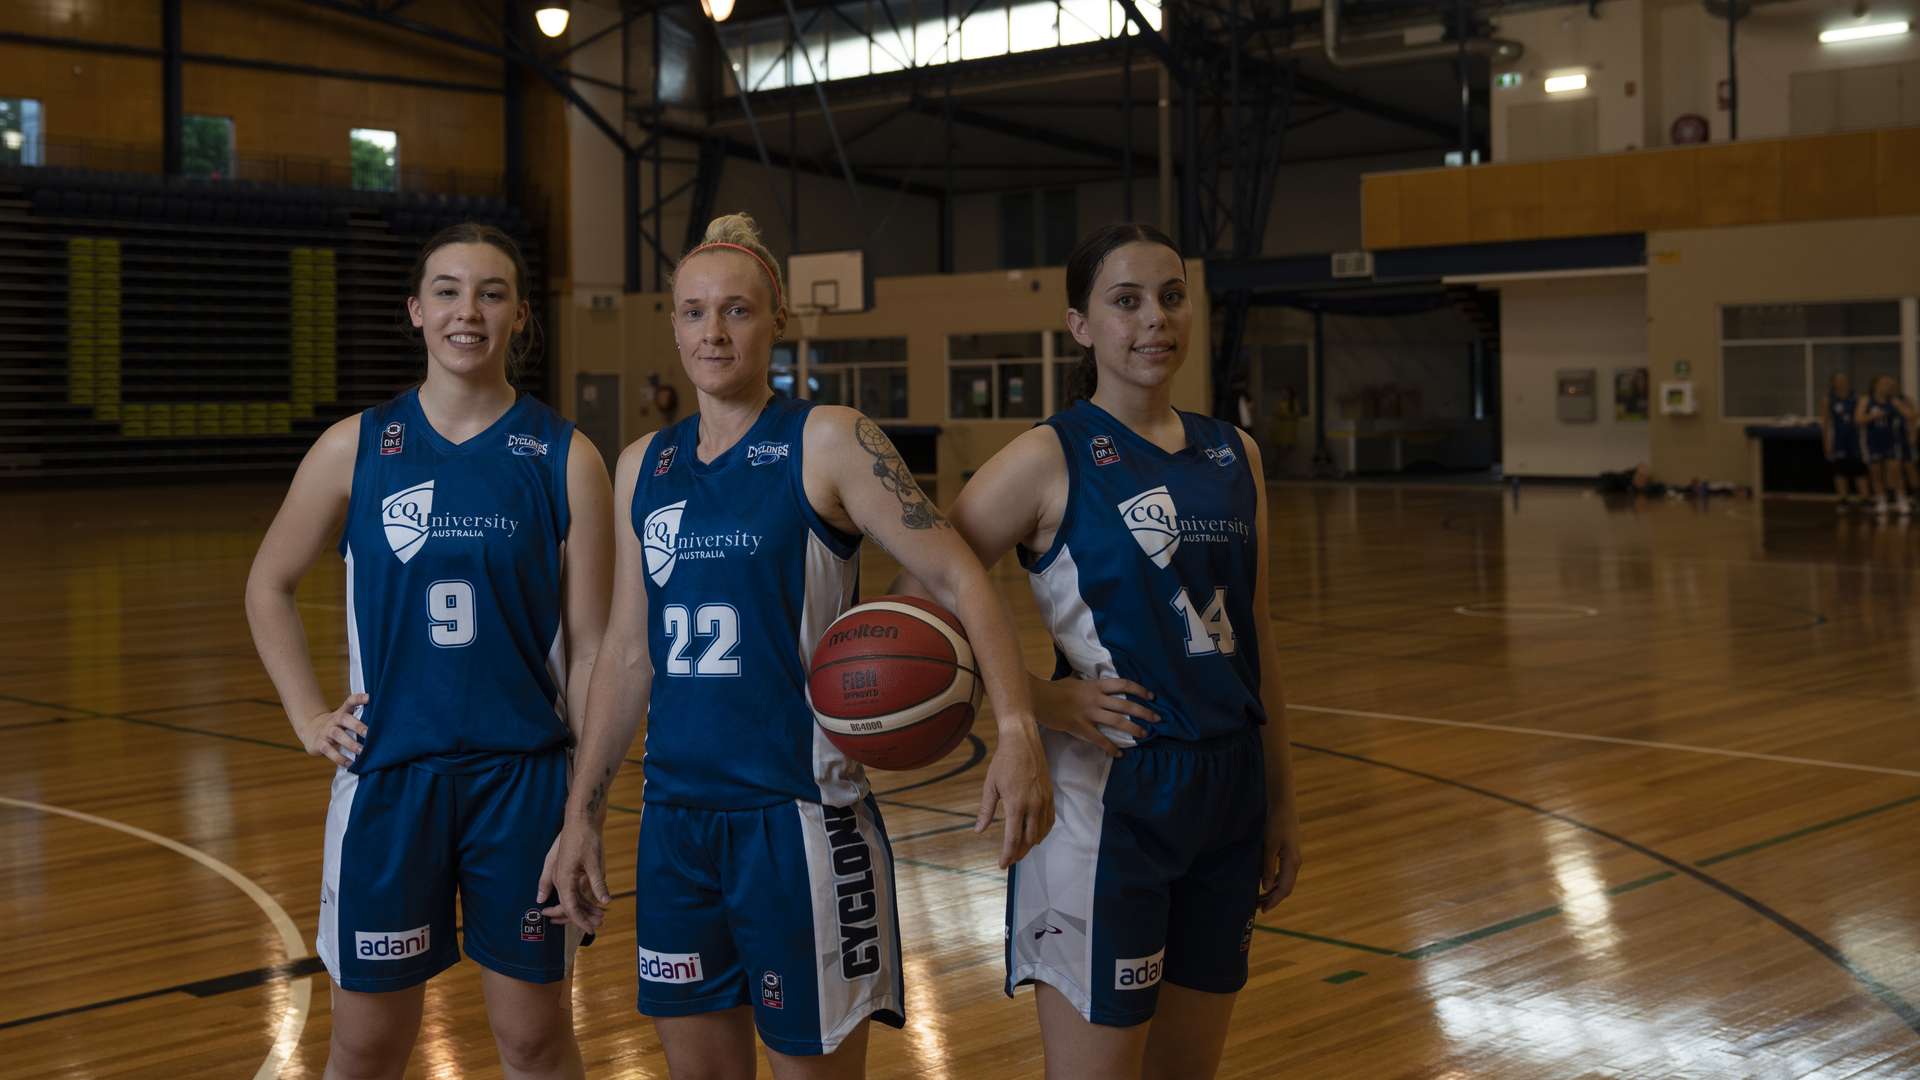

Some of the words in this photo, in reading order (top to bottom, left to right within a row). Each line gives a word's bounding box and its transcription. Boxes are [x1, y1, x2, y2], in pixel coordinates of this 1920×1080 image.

[384, 438, 401, 447] ONE
[507, 434, 548, 456] CYCLONES
[747, 444, 789, 459] CYCLONES
[388, 501, 519, 538] CQUniversity
[431, 529, 484, 538] AUSTRALIA
[646, 521, 763, 556] CQUniversity
[1183, 533, 1230, 543] AUSTRALIA
[678, 550, 726, 560] AUSTRALIA
[426, 579, 477, 648] 9
[1169, 586, 1236, 657] 14
[663, 602, 742, 678] 22
[828, 623, 900, 648] molten
[850, 720, 883, 732] BG4000
[359, 929, 427, 957] adani
[640, 954, 698, 979] adani
[764, 988, 781, 1000] ONE
